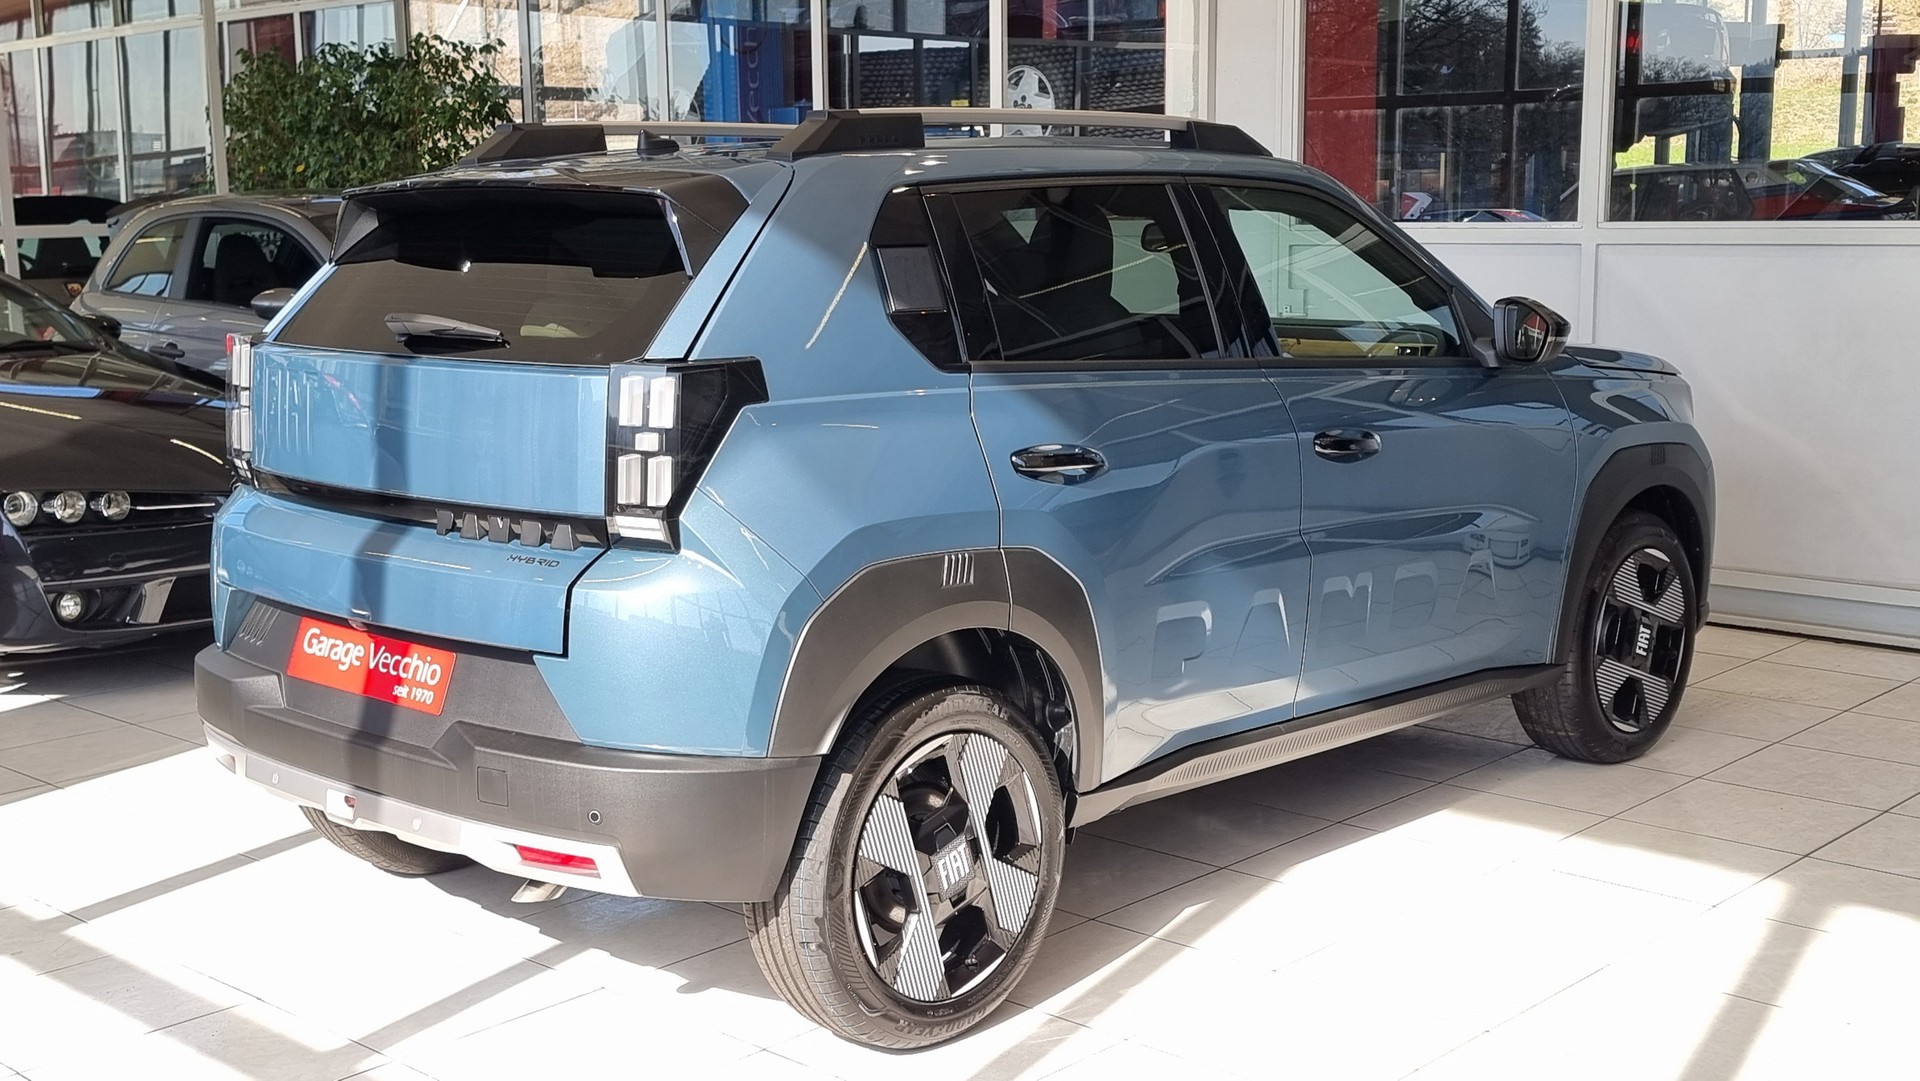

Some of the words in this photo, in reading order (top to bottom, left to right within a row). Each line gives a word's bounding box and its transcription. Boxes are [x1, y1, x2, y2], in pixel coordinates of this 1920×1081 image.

[435, 508, 577, 551] PANDA
[506, 554, 560, 568] HYBRID
[1149, 549, 1497, 690] PANDA
[1635, 624, 1651, 656] FIAT
[303, 628, 365, 671] Garage
[369, 642, 442, 686] Vecchio
[392, 684, 409, 698] seit
[411, 687, 434, 705] 1970
[937, 842, 970, 891] FIAT
